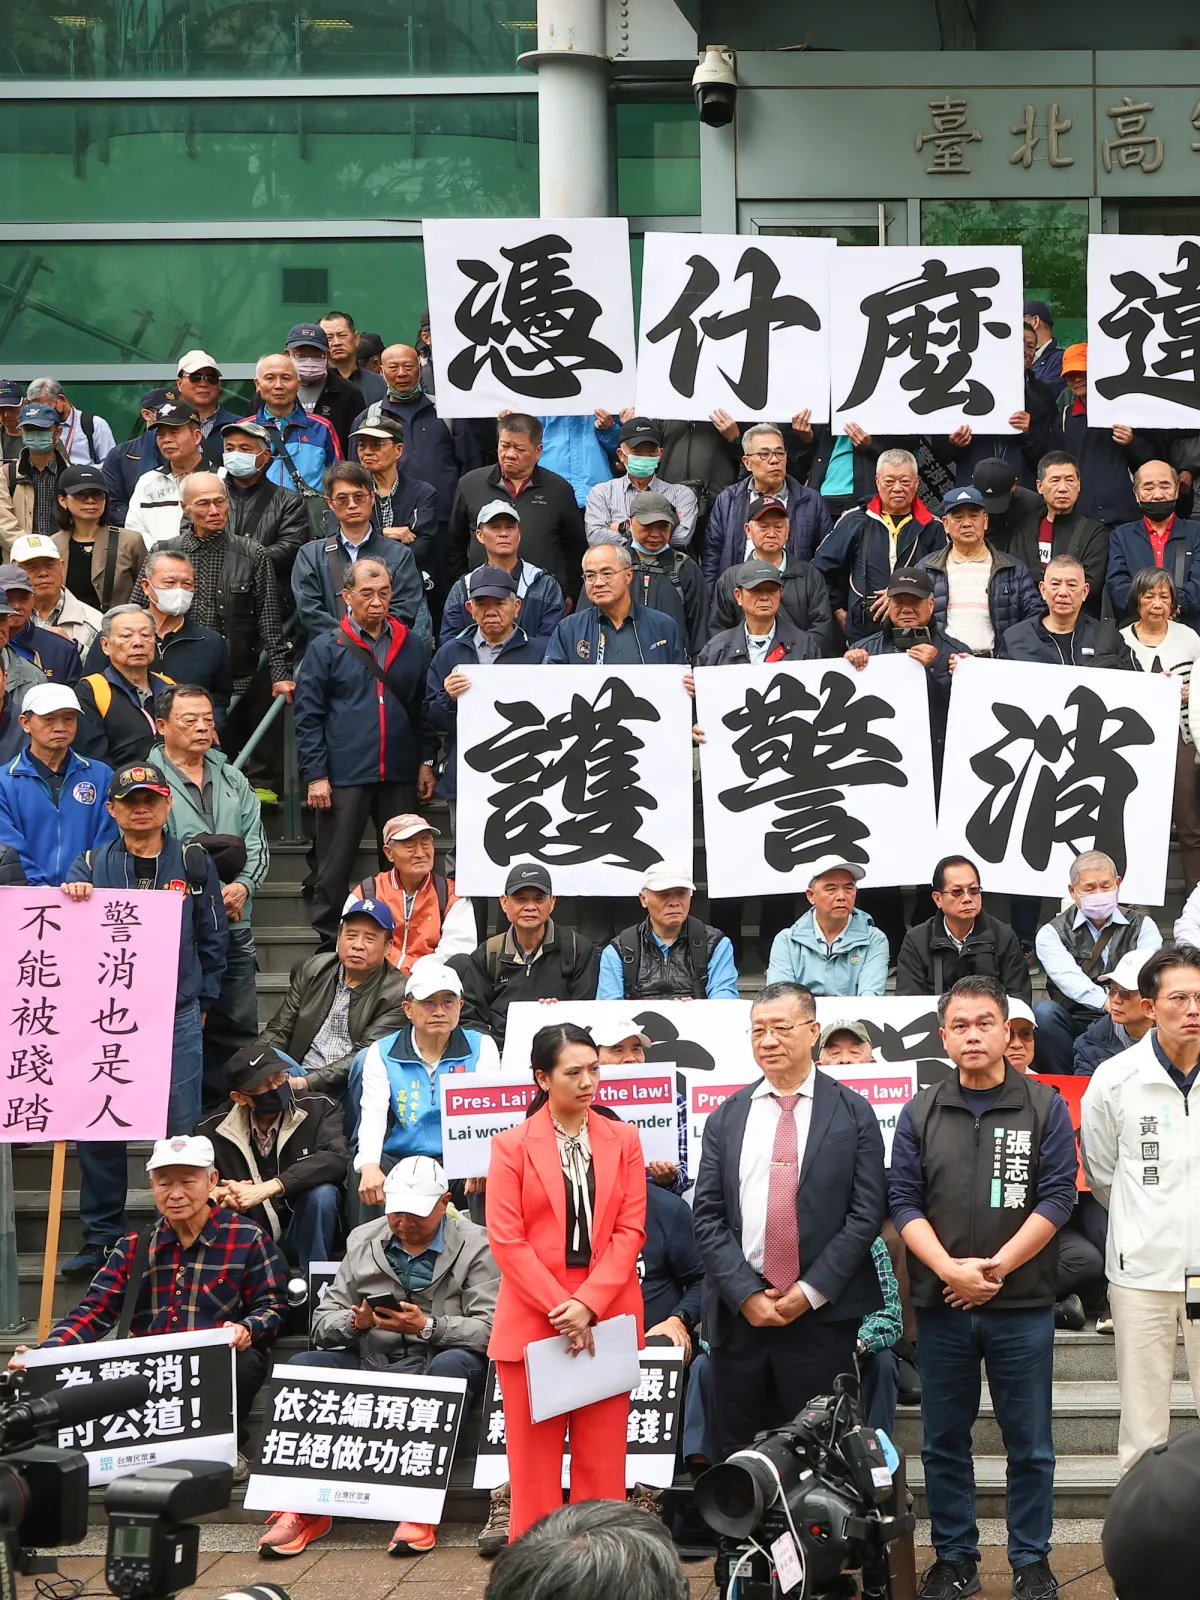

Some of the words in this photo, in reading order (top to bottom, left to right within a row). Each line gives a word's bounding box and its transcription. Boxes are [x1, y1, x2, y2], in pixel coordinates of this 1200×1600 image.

[2, 904, 63, 1133] 不能被踐踏
[86, 900, 143, 1128] 警消也是人
[451, 1095, 496, 1111] Pres.
[501, 1091, 527, 1108] Lai
[599, 1086, 628, 1101] the
[632, 1083, 670, 1100] law!
[873, 1084, 909, 1099] law!
[448, 1126, 472, 1141] Lai
[1140, 1115, 1160, 1186] 黃國昌
[1003, 1129, 1032, 1210] 張志豪
[273, 1386, 458, 1435] 依法編預算!
[260, 1428, 450, 1479] 拒絕做功德!
